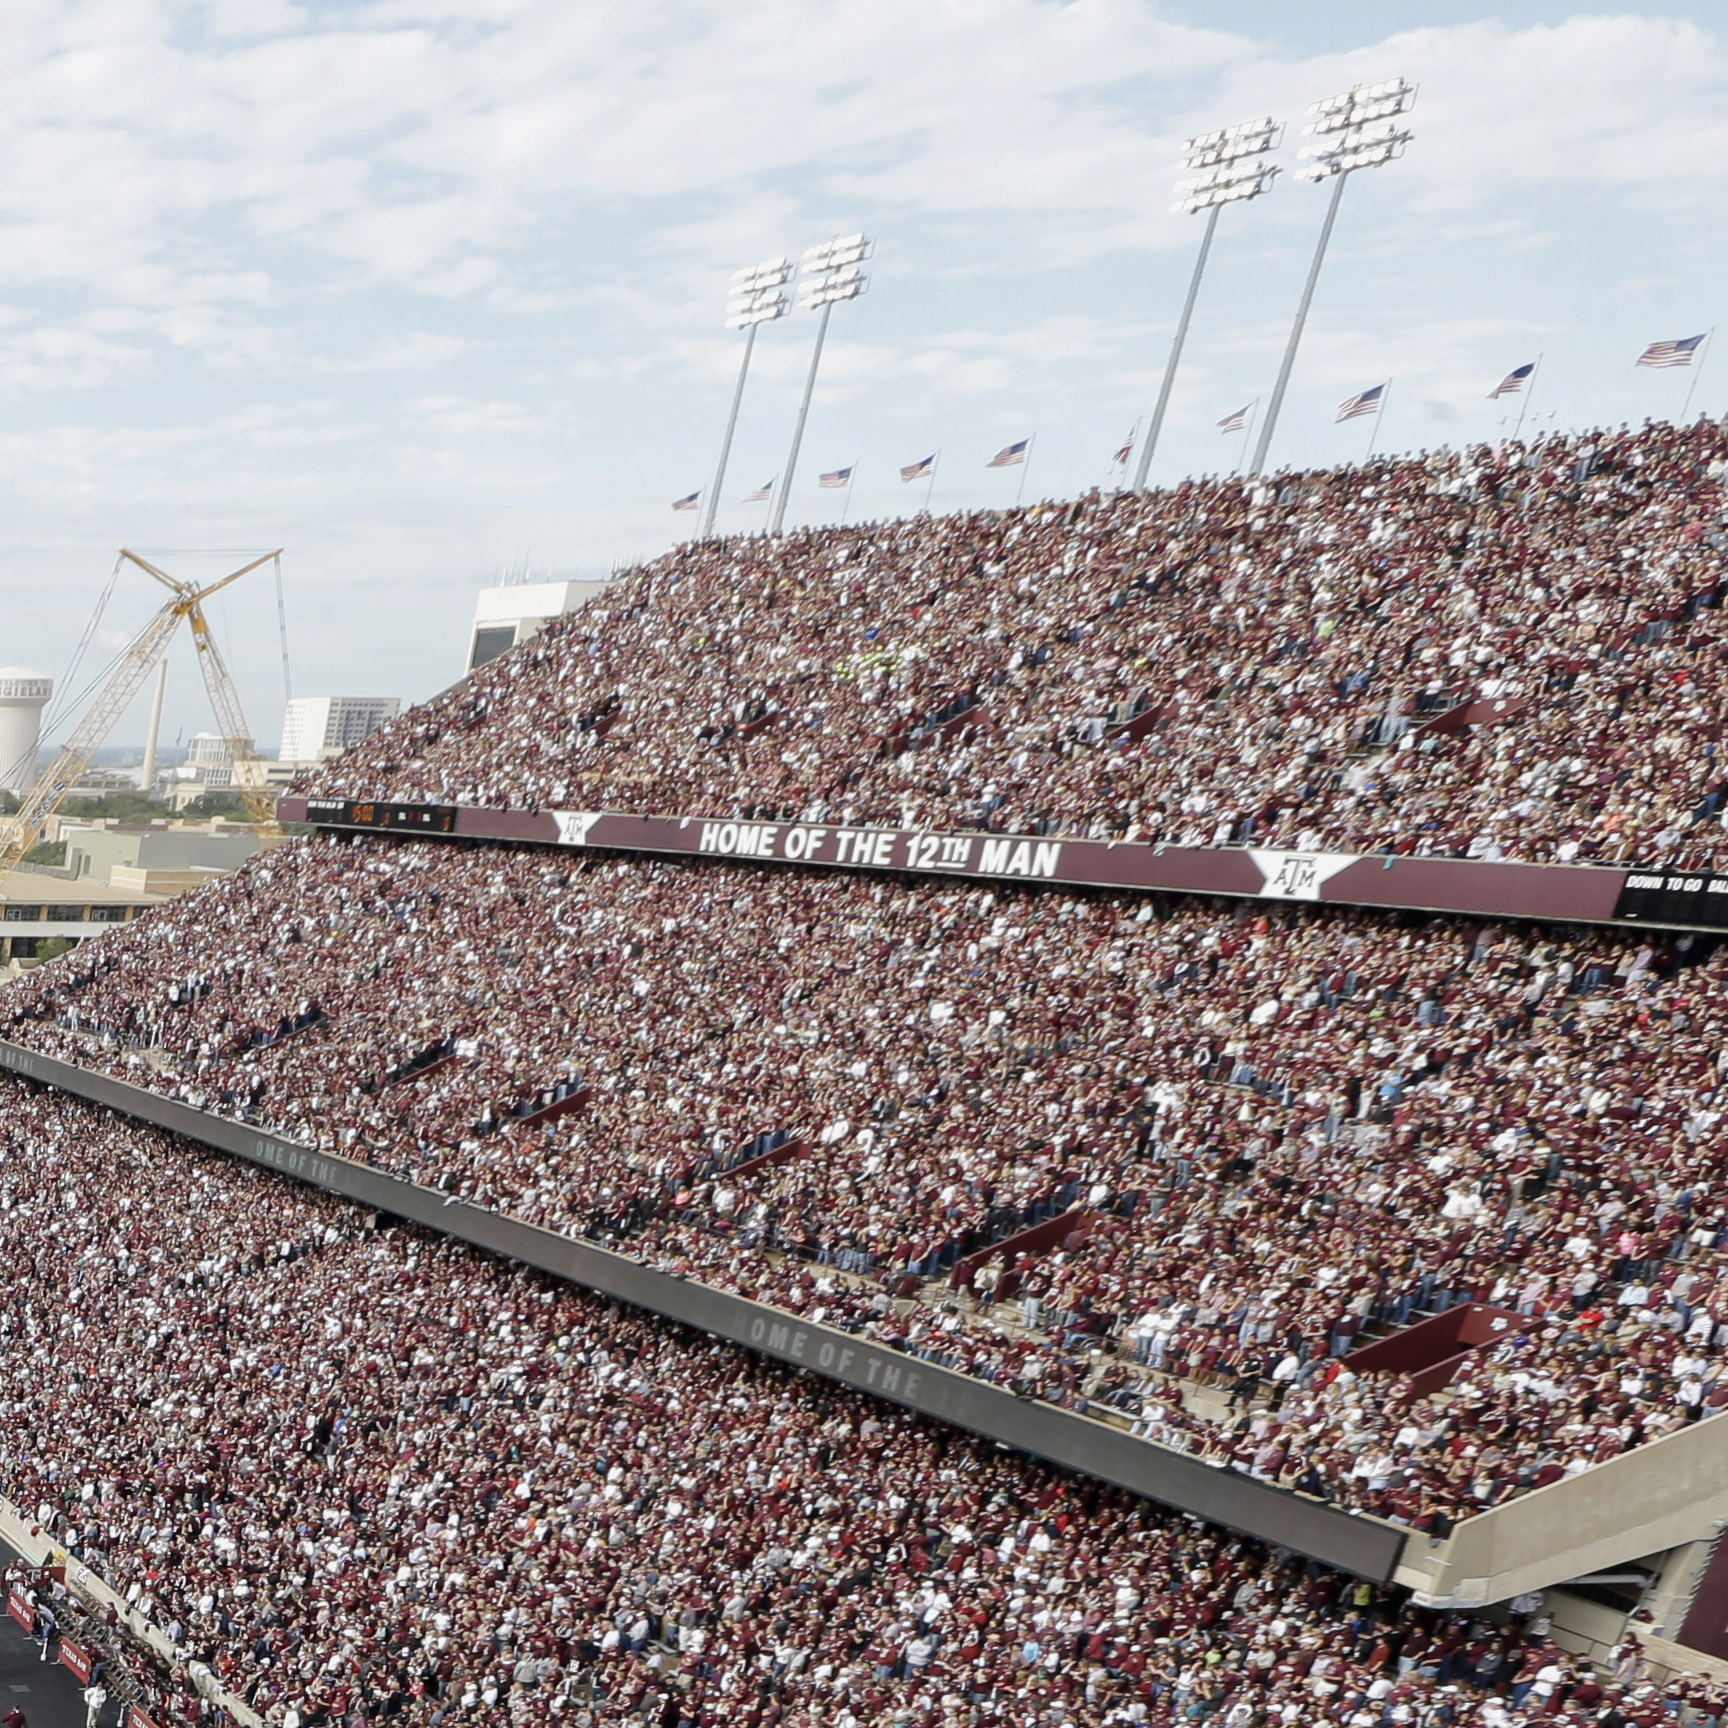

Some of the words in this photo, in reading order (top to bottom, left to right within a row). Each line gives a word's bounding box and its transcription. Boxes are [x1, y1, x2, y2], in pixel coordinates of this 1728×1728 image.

[699, 823, 778, 857] HOME
[784, 827, 828, 860] OF
[835, 831, 897, 865] THE
[905, 834, 973, 869] 12TH
[978, 840, 1062, 877] MAN
[1625, 875, 1663, 889] DOWN
[1666, 877, 1683, 890] TO
[1684, 878, 1703, 892] GO
[255, 1141, 283, 1165] OME
[289, 1153, 306, 1172] OF
[312, 1160, 337, 1184] THE
[750, 1318, 808, 1358] OME
[818, 1343, 856, 1373] OF
[867, 1358, 922, 1399] THE
